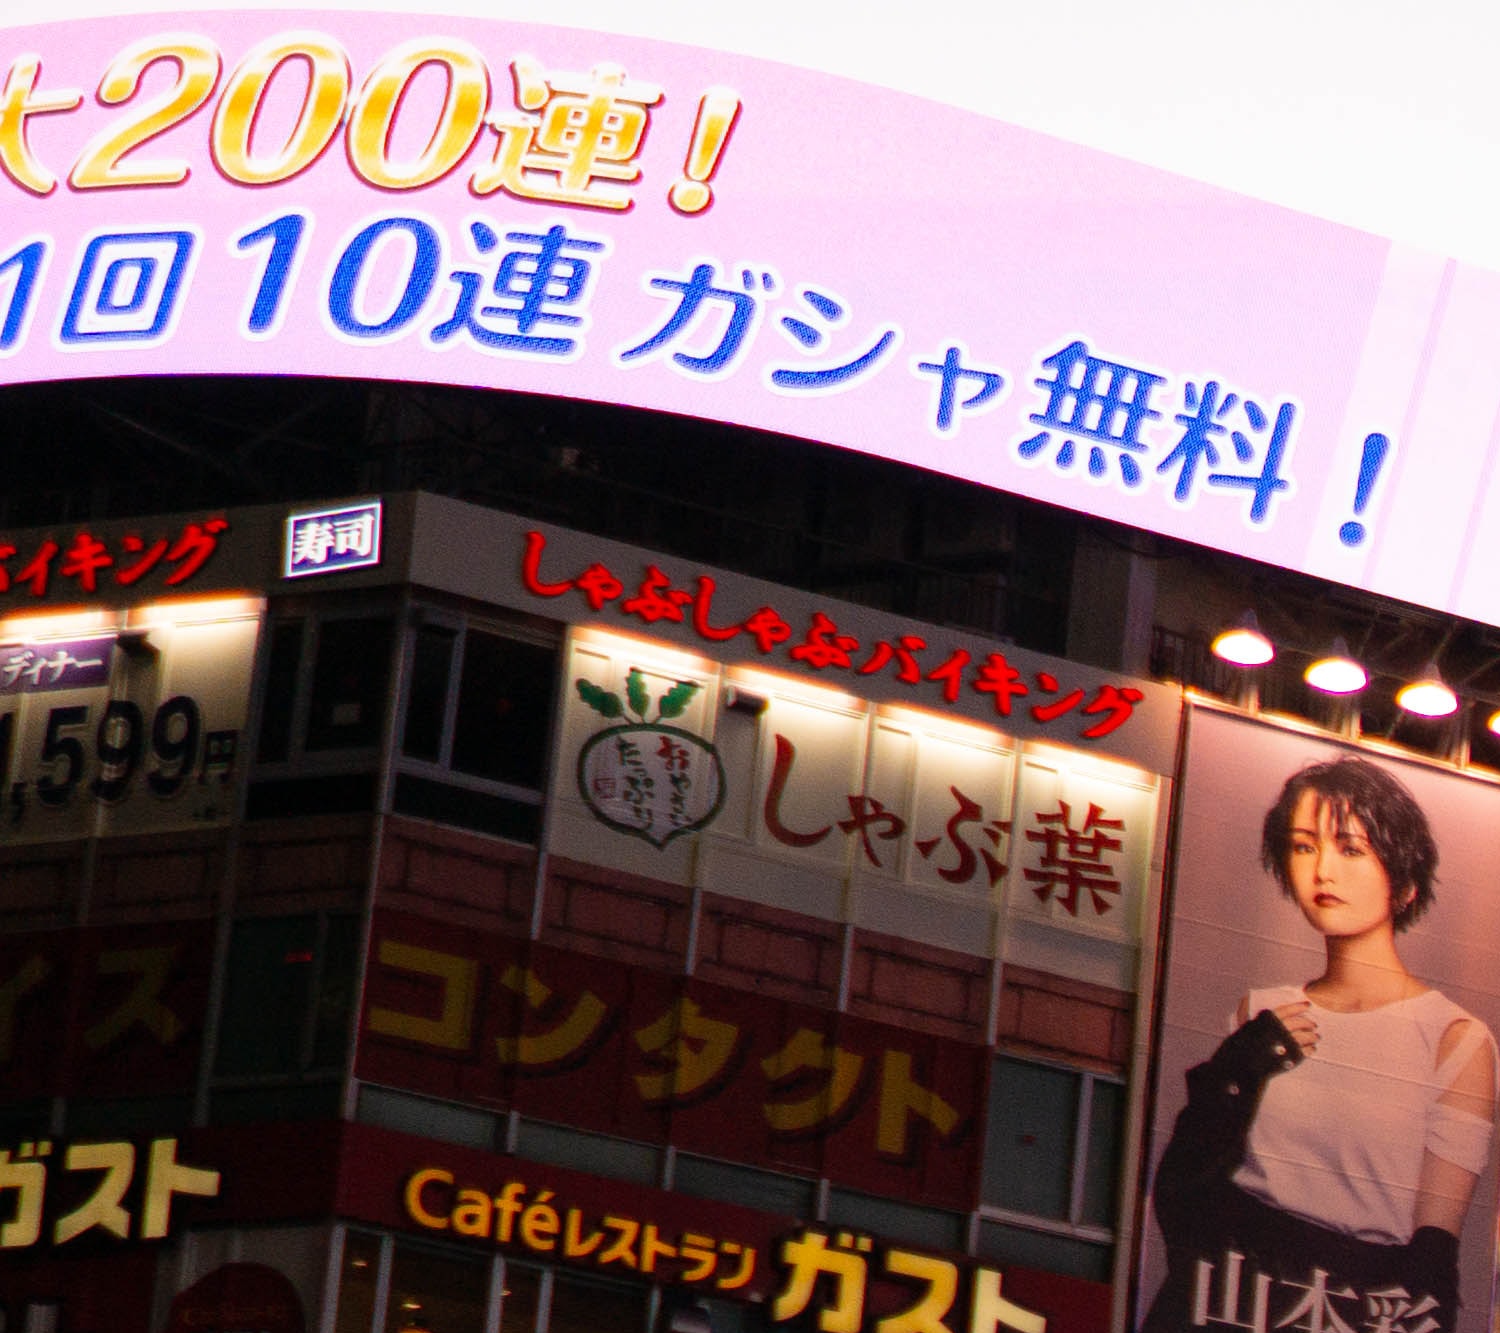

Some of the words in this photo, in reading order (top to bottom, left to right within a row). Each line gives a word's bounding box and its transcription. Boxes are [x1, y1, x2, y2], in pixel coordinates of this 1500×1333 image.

[292, 514, 375, 565] 寿司
[2, 650, 104, 688] ディナー
[521, 531, 1144, 738] しゃぶしゃぶバイキング
[763, 733, 1124, 917] しゃぶ葉
[368, 940, 960, 1155] コンタクト
[0, 1137, 221, 1250] ガスト
